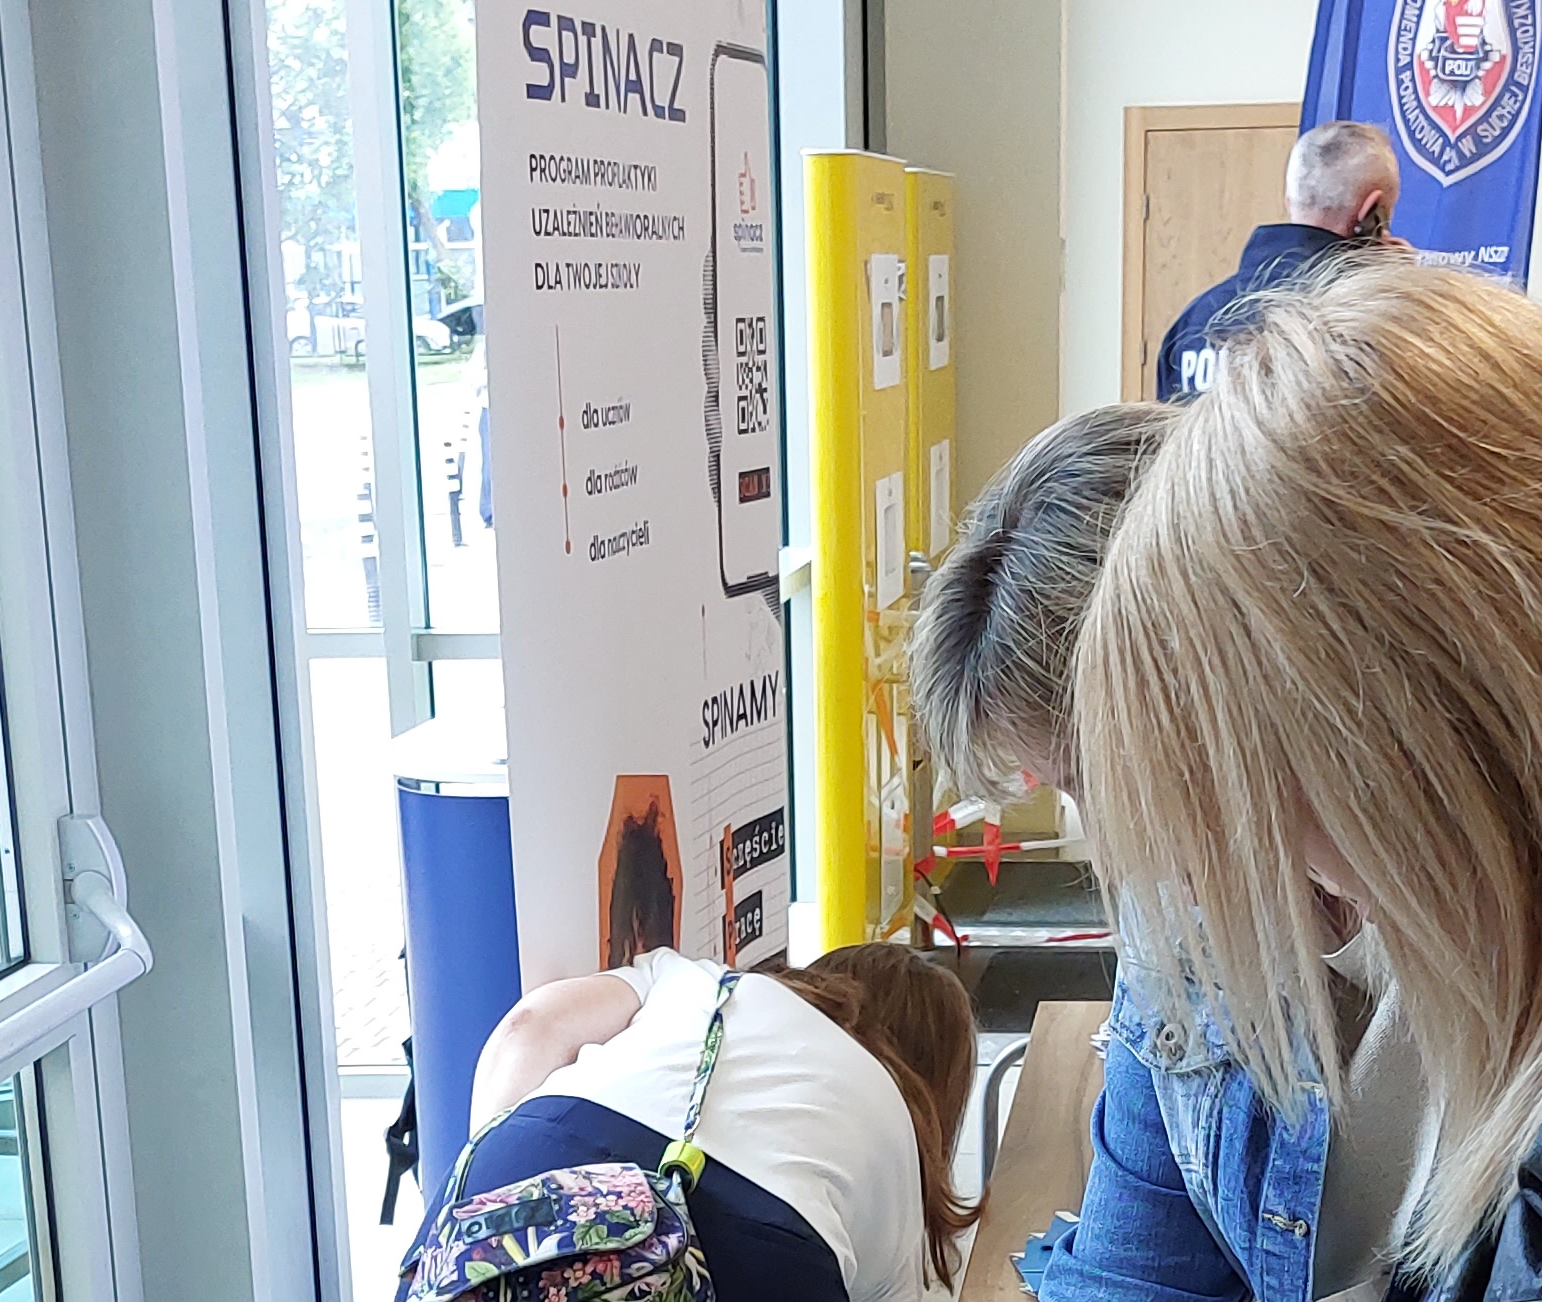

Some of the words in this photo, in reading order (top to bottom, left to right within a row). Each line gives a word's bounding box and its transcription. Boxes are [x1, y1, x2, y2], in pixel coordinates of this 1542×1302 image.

[523, 9, 686, 123] SPINACZ
[1398, 70, 1444, 158] POWIATOWA
[1477, 86, 1524, 143] SUCHEJ
[529, 154, 592, 185] PROGRAM
[532, 202, 603, 237] UZALEŻNIEŃ
[535, 262, 563, 290] DLA
[565, 263, 608, 290] TWOJEJ
[582, 402, 599, 429] dla
[586, 469, 603, 496] dla
[589, 535, 606, 561] dla
[607, 520, 650, 557] nauczycieli
[701, 670, 779, 749] SPINAMY
